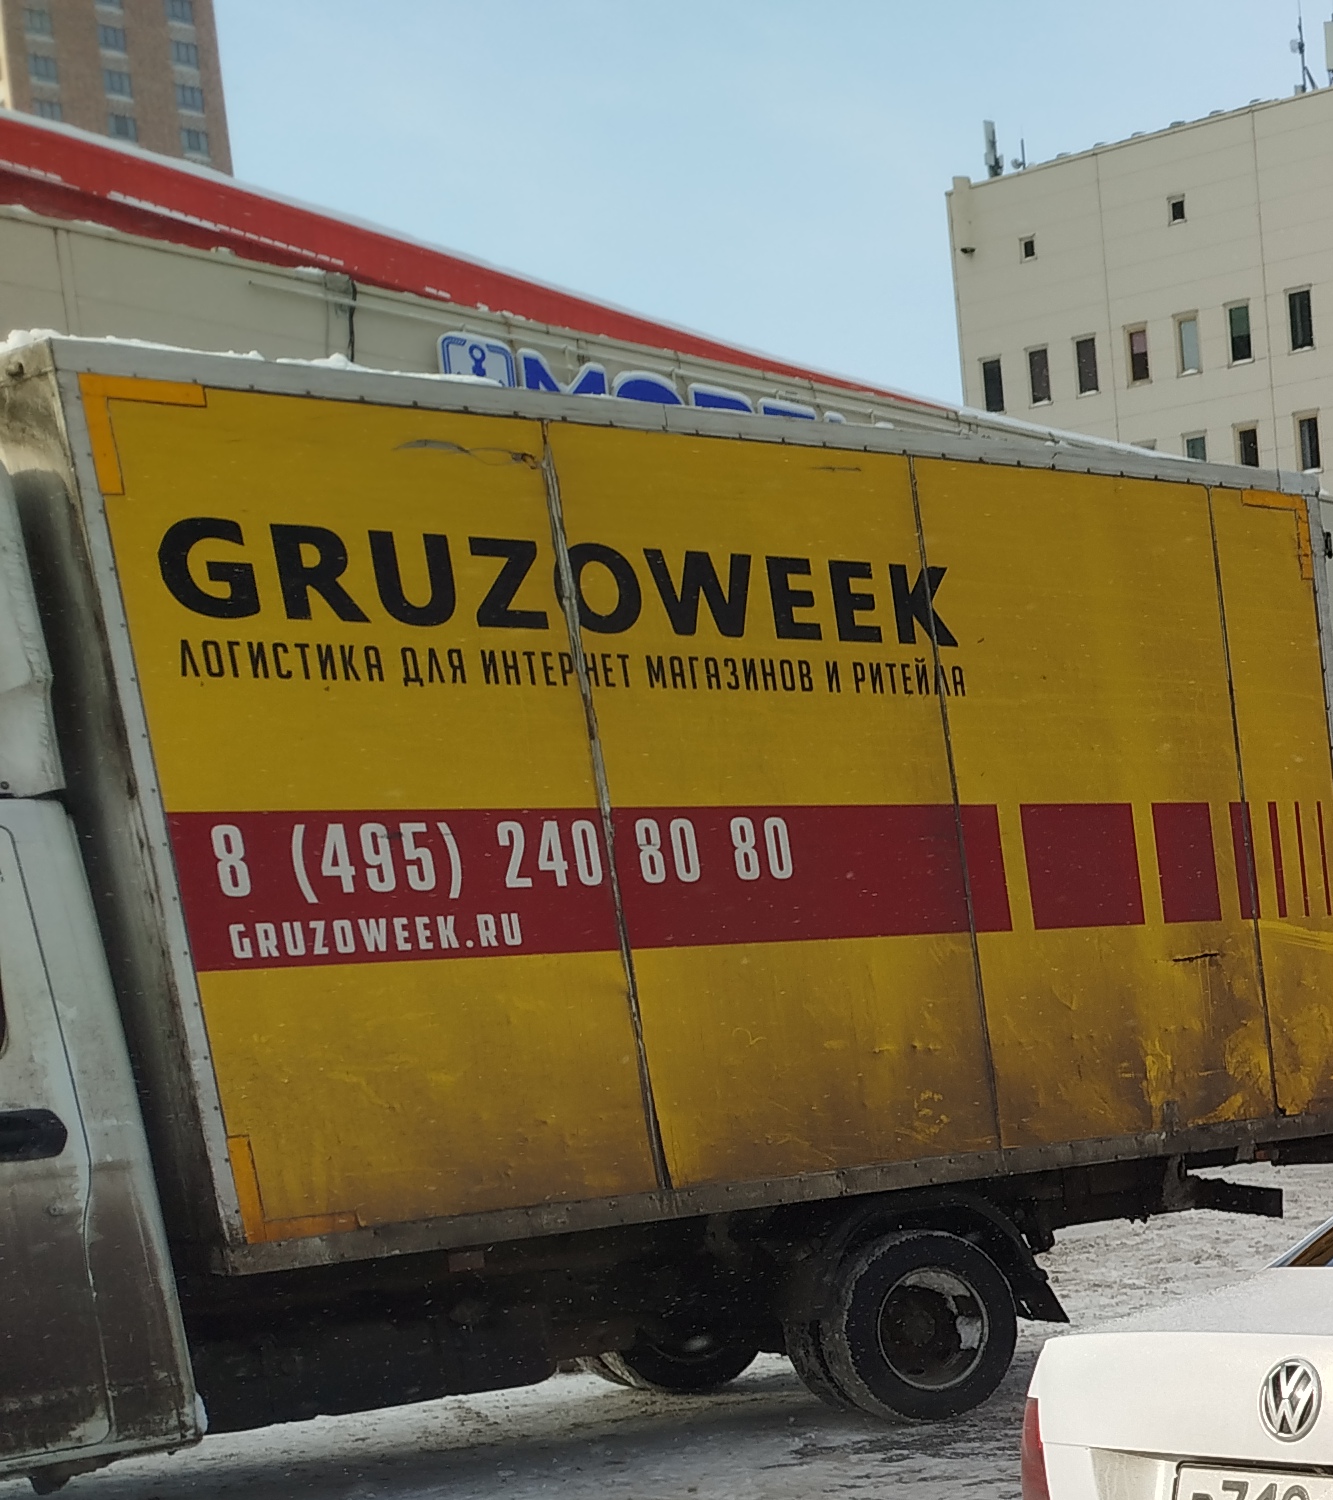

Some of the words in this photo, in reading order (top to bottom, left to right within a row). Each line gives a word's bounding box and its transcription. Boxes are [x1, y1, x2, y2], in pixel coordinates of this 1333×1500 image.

[158, 516, 960, 647] GRUZOWEEK
[180, 638, 385, 683] ЛОГИСТИКА
[401, 646, 467, 687] ДЛЯ
[647, 654, 814, 694] МАГАЗИНОВ
[826, 663, 842, 693] И
[853, 655, 966, 698] РИТЕЙЛА
[211, 823, 252, 897] 8
[291, 820, 463, 904] (495)
[497, 819, 604, 888] 240
[635, 817, 701, 883] 80
[729, 816, 794, 881] 80
[229, 911, 523, 959] GRUZOWEEK.RU
